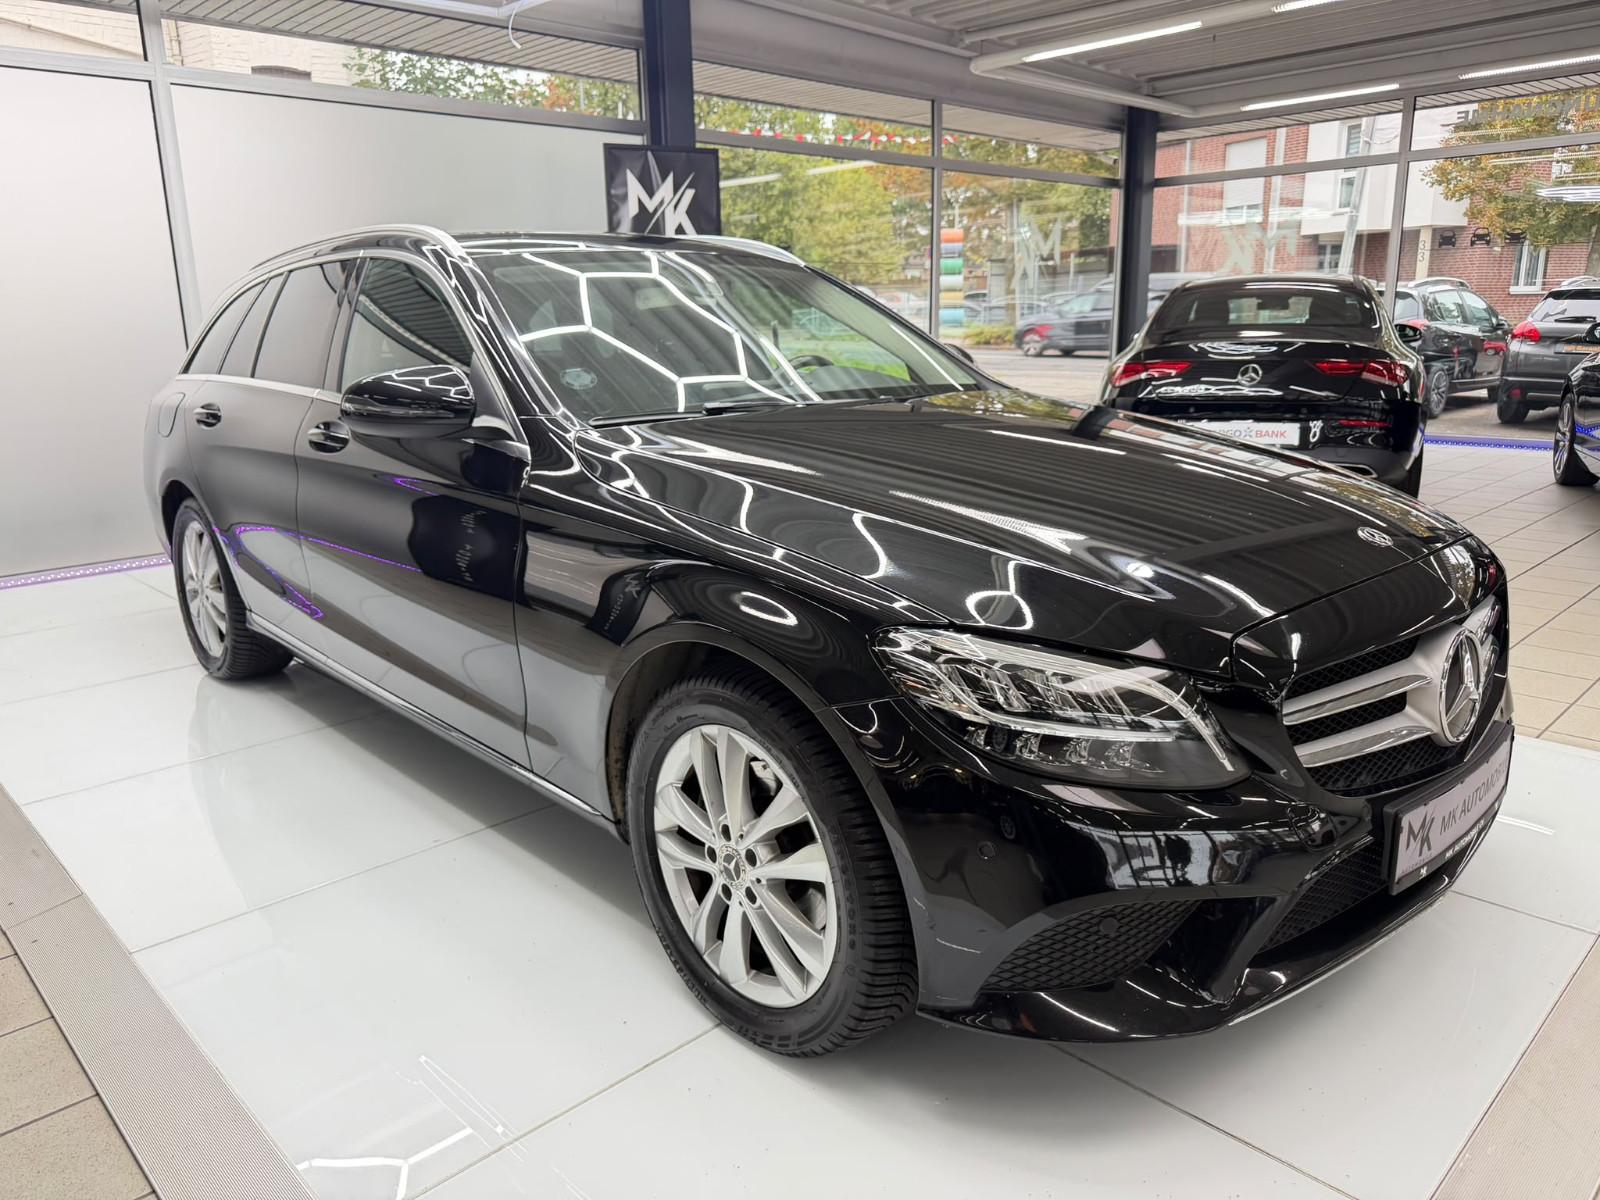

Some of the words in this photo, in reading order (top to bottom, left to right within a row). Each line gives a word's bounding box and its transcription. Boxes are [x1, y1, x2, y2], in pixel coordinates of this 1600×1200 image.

[626, 168, 697, 236] MK
[1255, 430, 1287, 439] BANK
[1406, 811, 1435, 857] MK
[1440, 804, 1458, 836] MK
